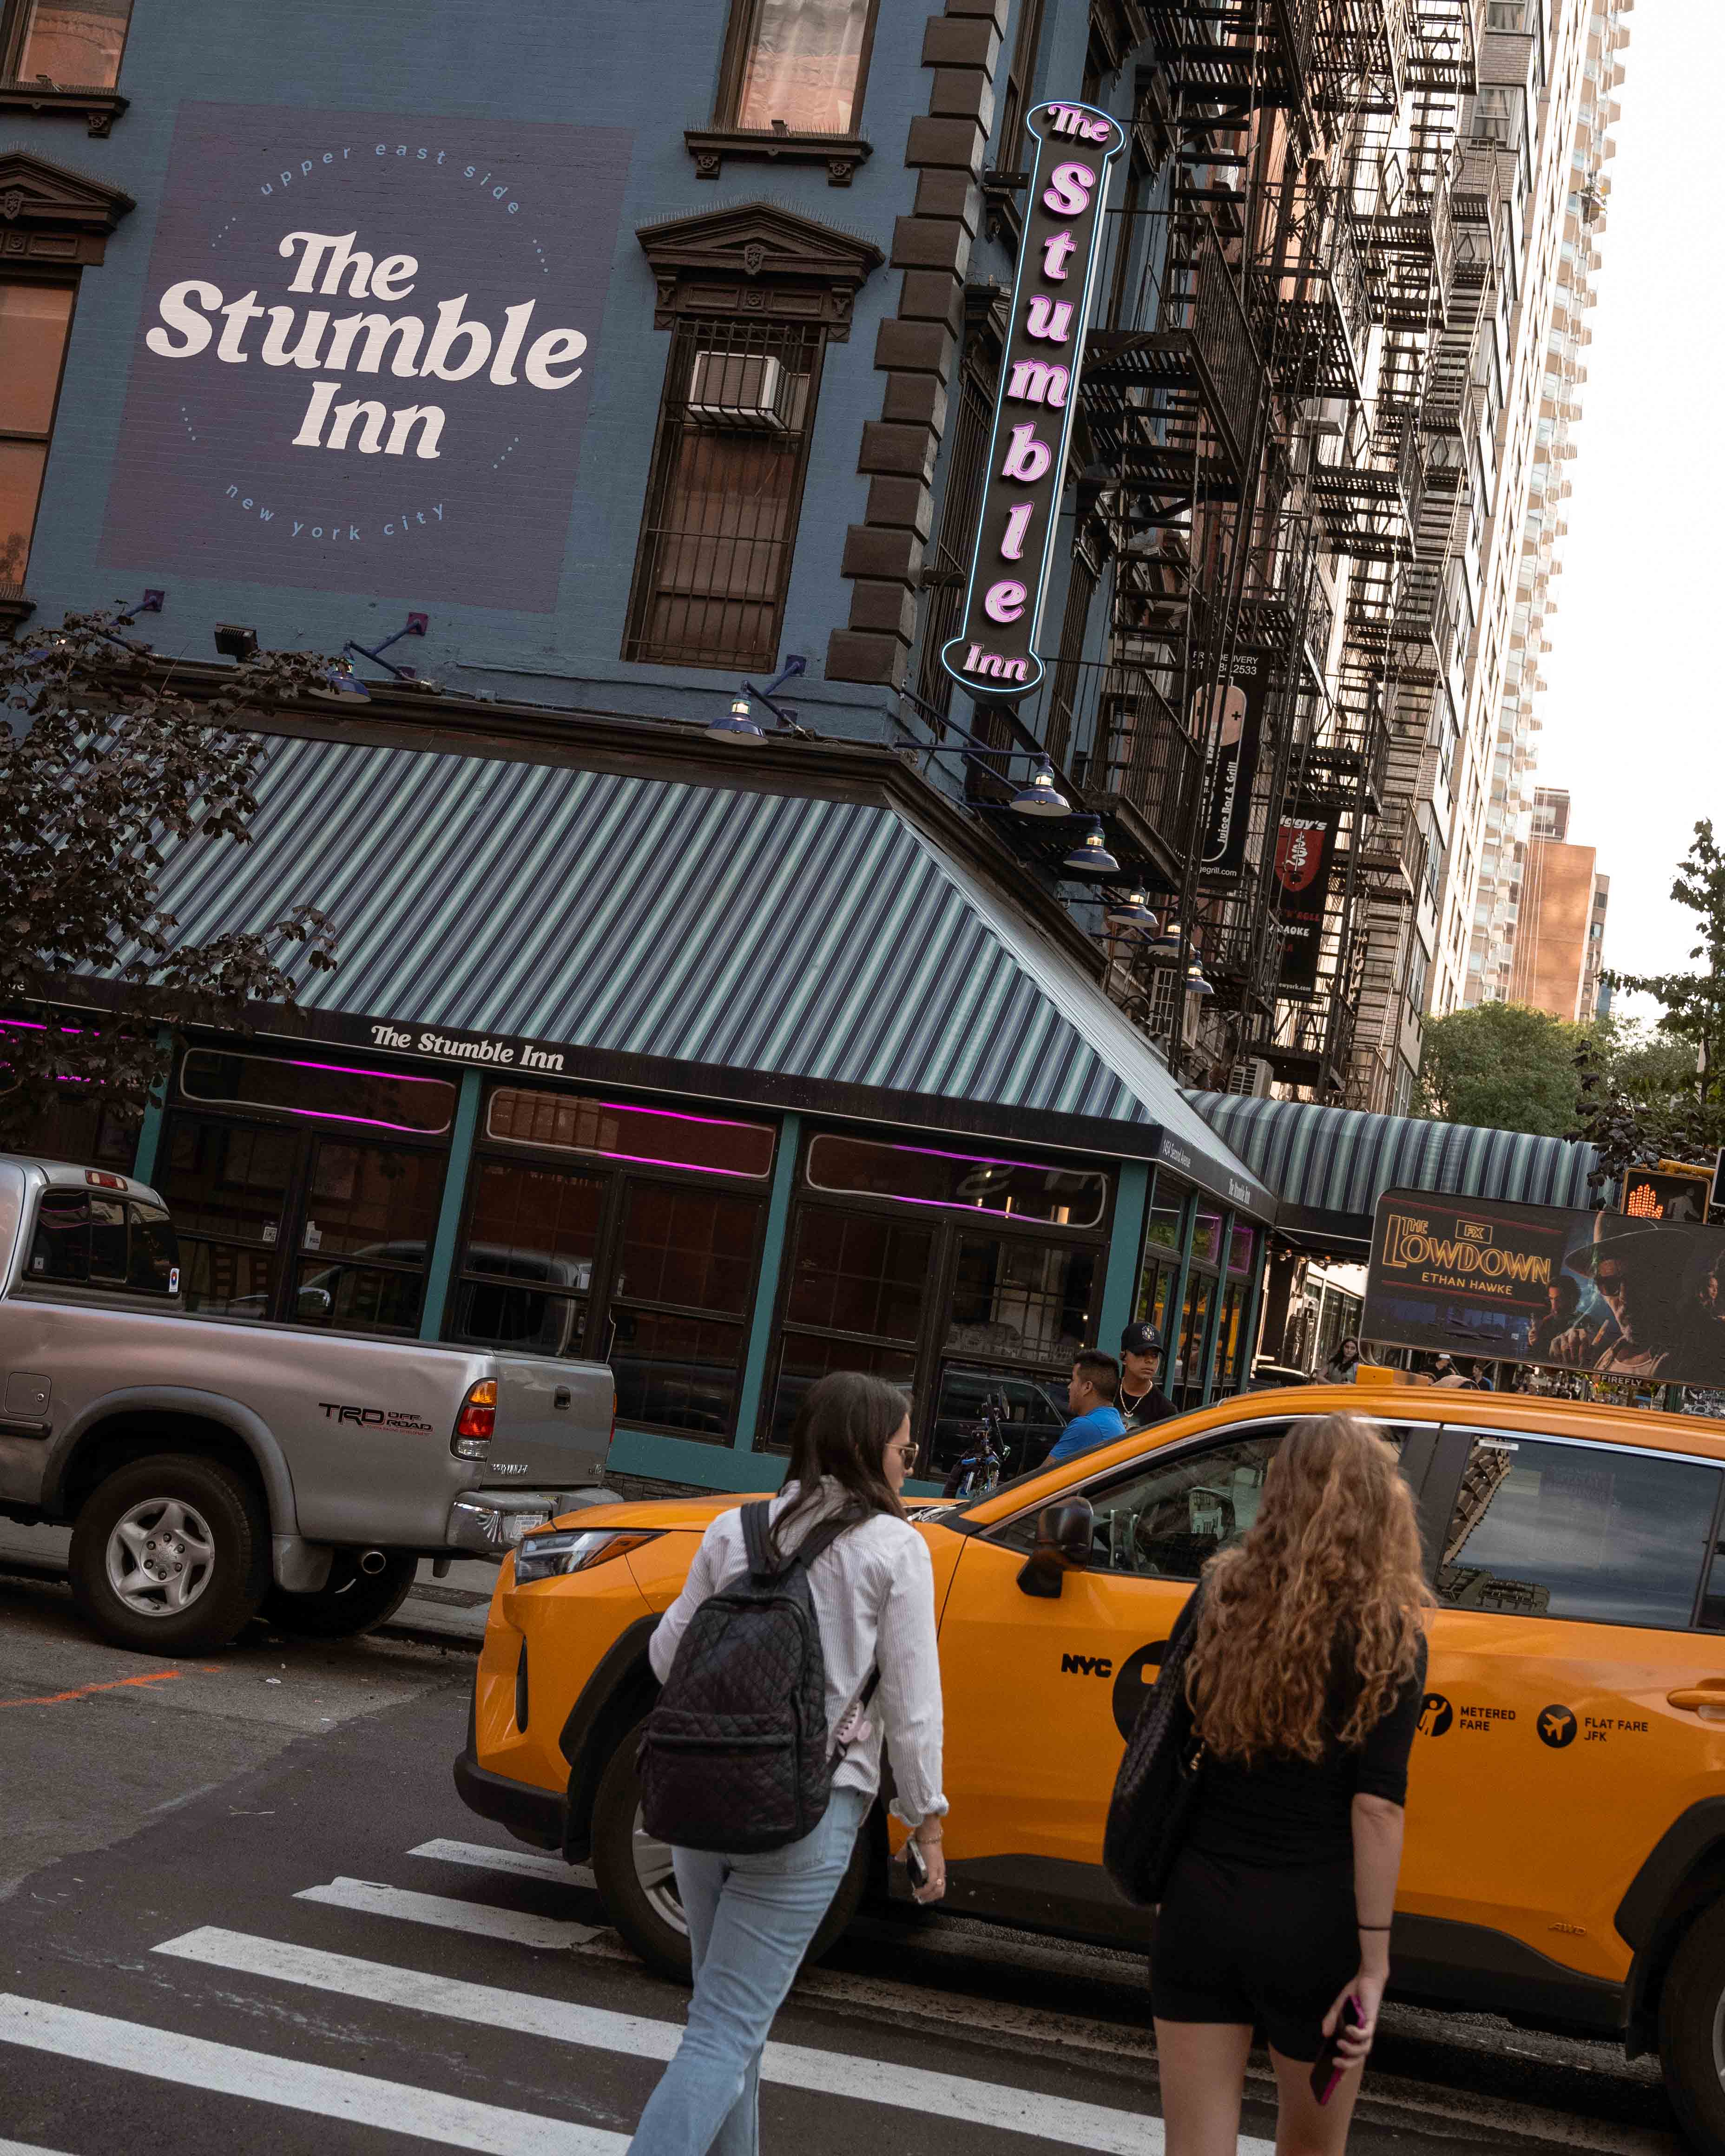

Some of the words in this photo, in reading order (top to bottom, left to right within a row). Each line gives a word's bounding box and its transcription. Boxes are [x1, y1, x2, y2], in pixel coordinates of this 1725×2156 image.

[1047, 104, 1112, 142] The
[261, 148, 351, 196] upper
[375, 142, 447, 165] east
[463, 164, 519, 214] side
[278, 230, 419, 301] The
[145, 280, 587, 390] Stumble
[985, 162, 1095, 623] Stumble
[291, 381, 446, 459] Inn
[225, 483, 274, 522] new
[291, 519, 361, 541] york
[383, 500, 444, 536] city
[962, 642, 1028, 681] Inn
[1220, 653, 1259, 664] DEIVERY
[1226, 762, 1237, 782] Grill
[1222, 796, 1232, 813] Bar
[1217, 816, 1229, 843] Juice
[371, 1025, 412, 1048] The
[418, 1033, 514, 1063] Stumble
[519, 1045, 564, 1071] Inn
[1402, 1217, 1429, 1236] THE
[1464, 1224, 1484, 1240] FX
[1383, 1214, 1551, 1284] LOWDOWN
[1422, 1272, 1465, 1288] ETHAN
[1470, 1280, 1514, 1295] HAWKE
[1601, 1375, 1642, 1386] FIREFLY
[318, 1402, 386, 1427] TRD
[388, 1411, 422, 1421] OFF
[387, 1419, 433, 1432] ROAD
[1061, 1653, 1112, 1678] NYC
[1460, 1720, 1490, 1731] FARE
[1461, 1706, 1516, 1720] METERED
[1585, 1717, 1614, 1729] FLAT
[1618, 1720, 1648, 1732] FARE
[1584, 1731, 1606, 1742] JFK
[1548, 1921, 1587, 1936] AWD
